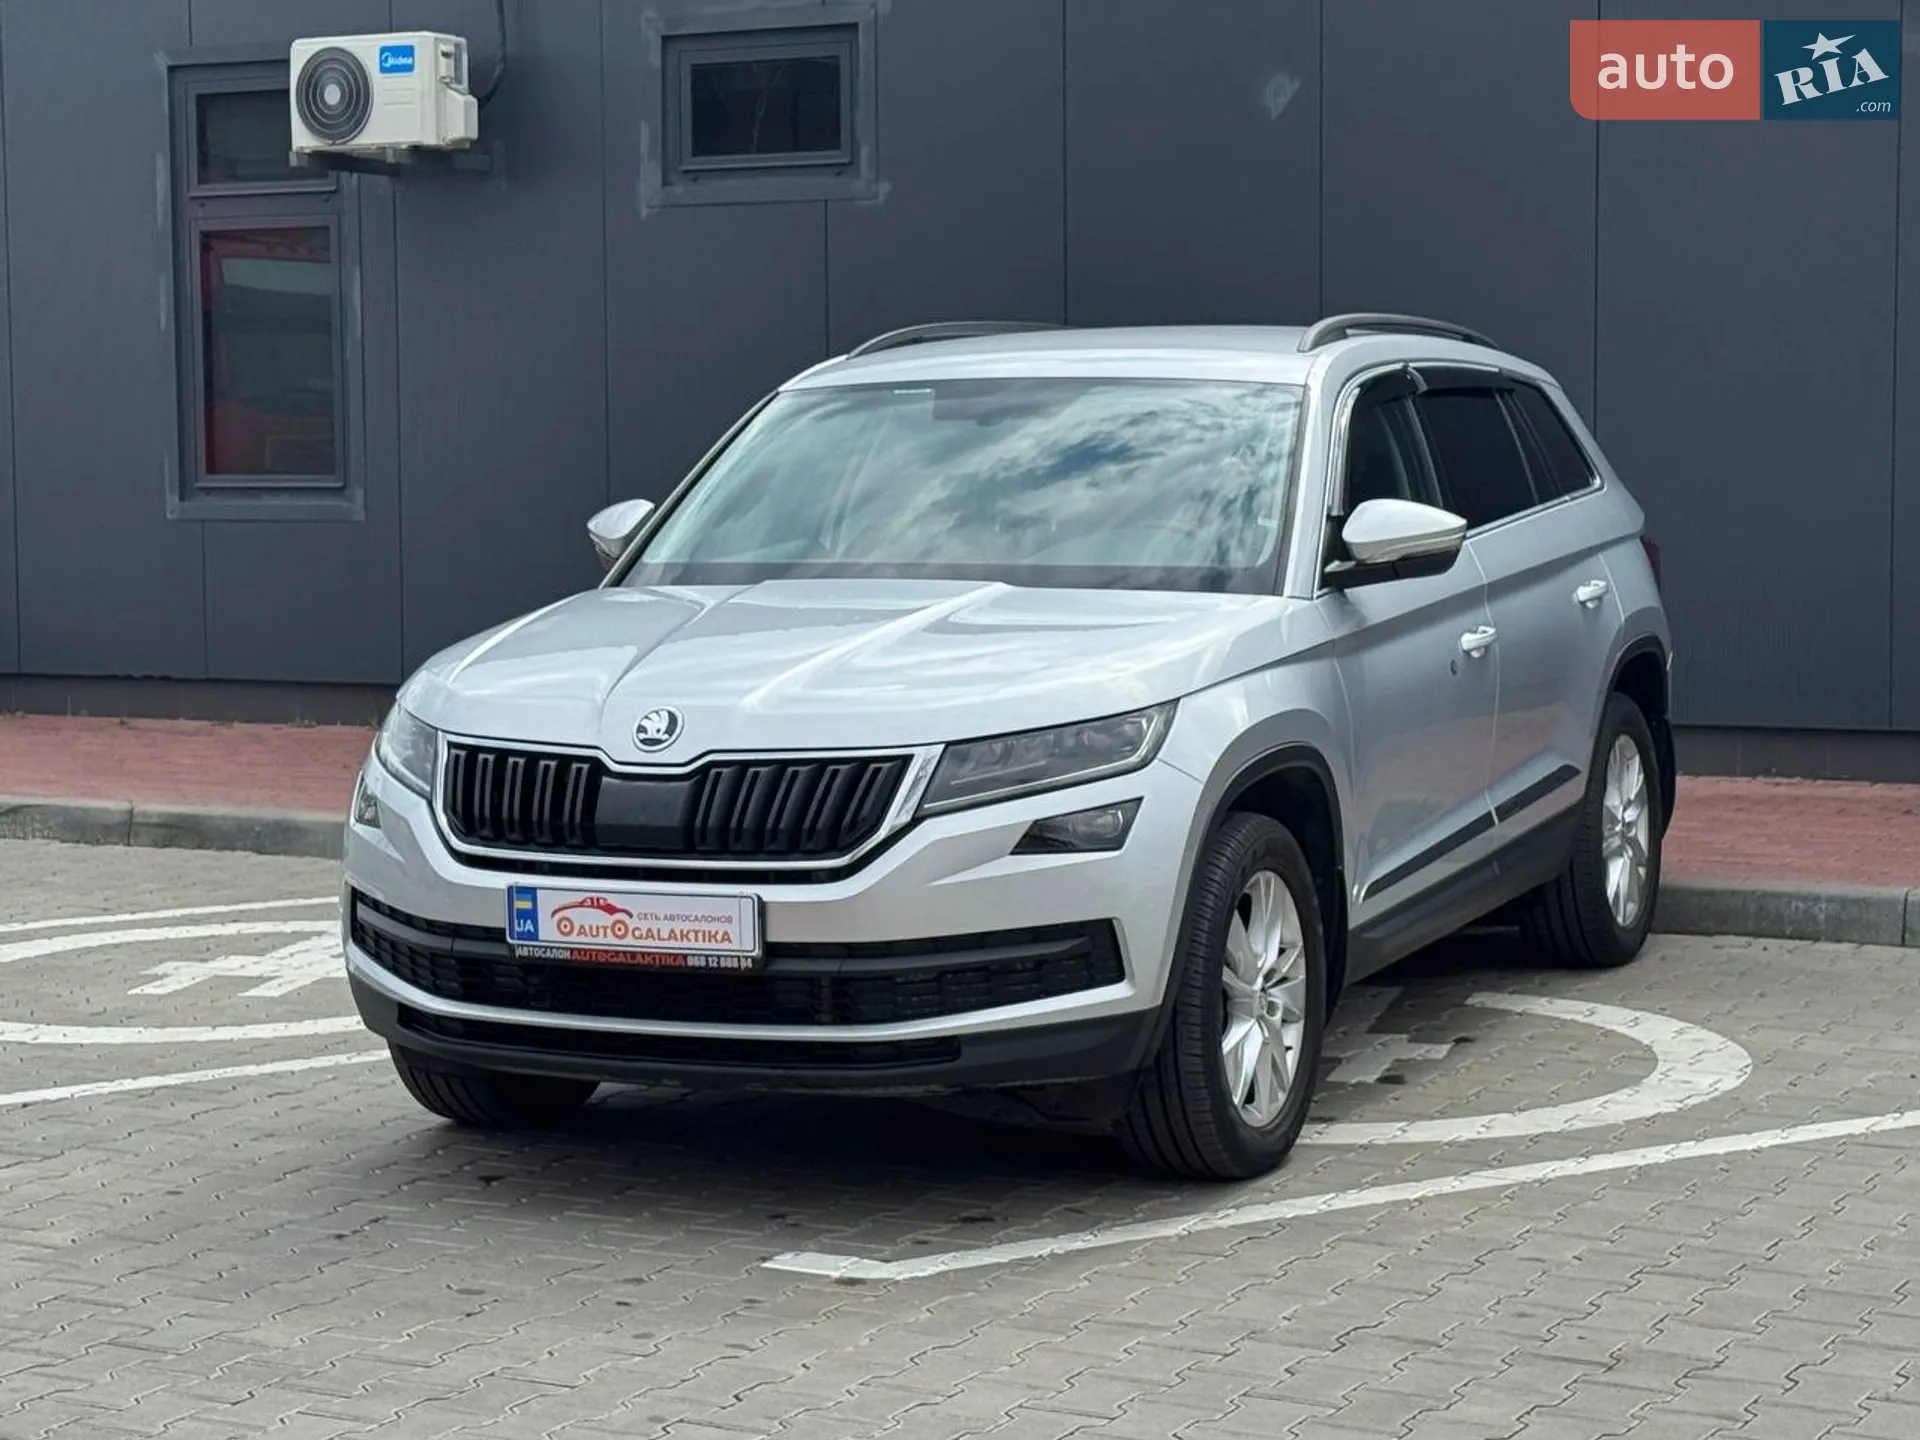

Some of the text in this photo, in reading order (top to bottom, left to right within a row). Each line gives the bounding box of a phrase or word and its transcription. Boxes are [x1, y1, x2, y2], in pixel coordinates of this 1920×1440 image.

[637, 912, 733, 924] СЕТЬ АВТОСАЛОНОВ
[515, 919, 535, 933] UA
[572, 949, 685, 966] AUTOGALAKTIKA
[707, 956, 719, 968] 12
